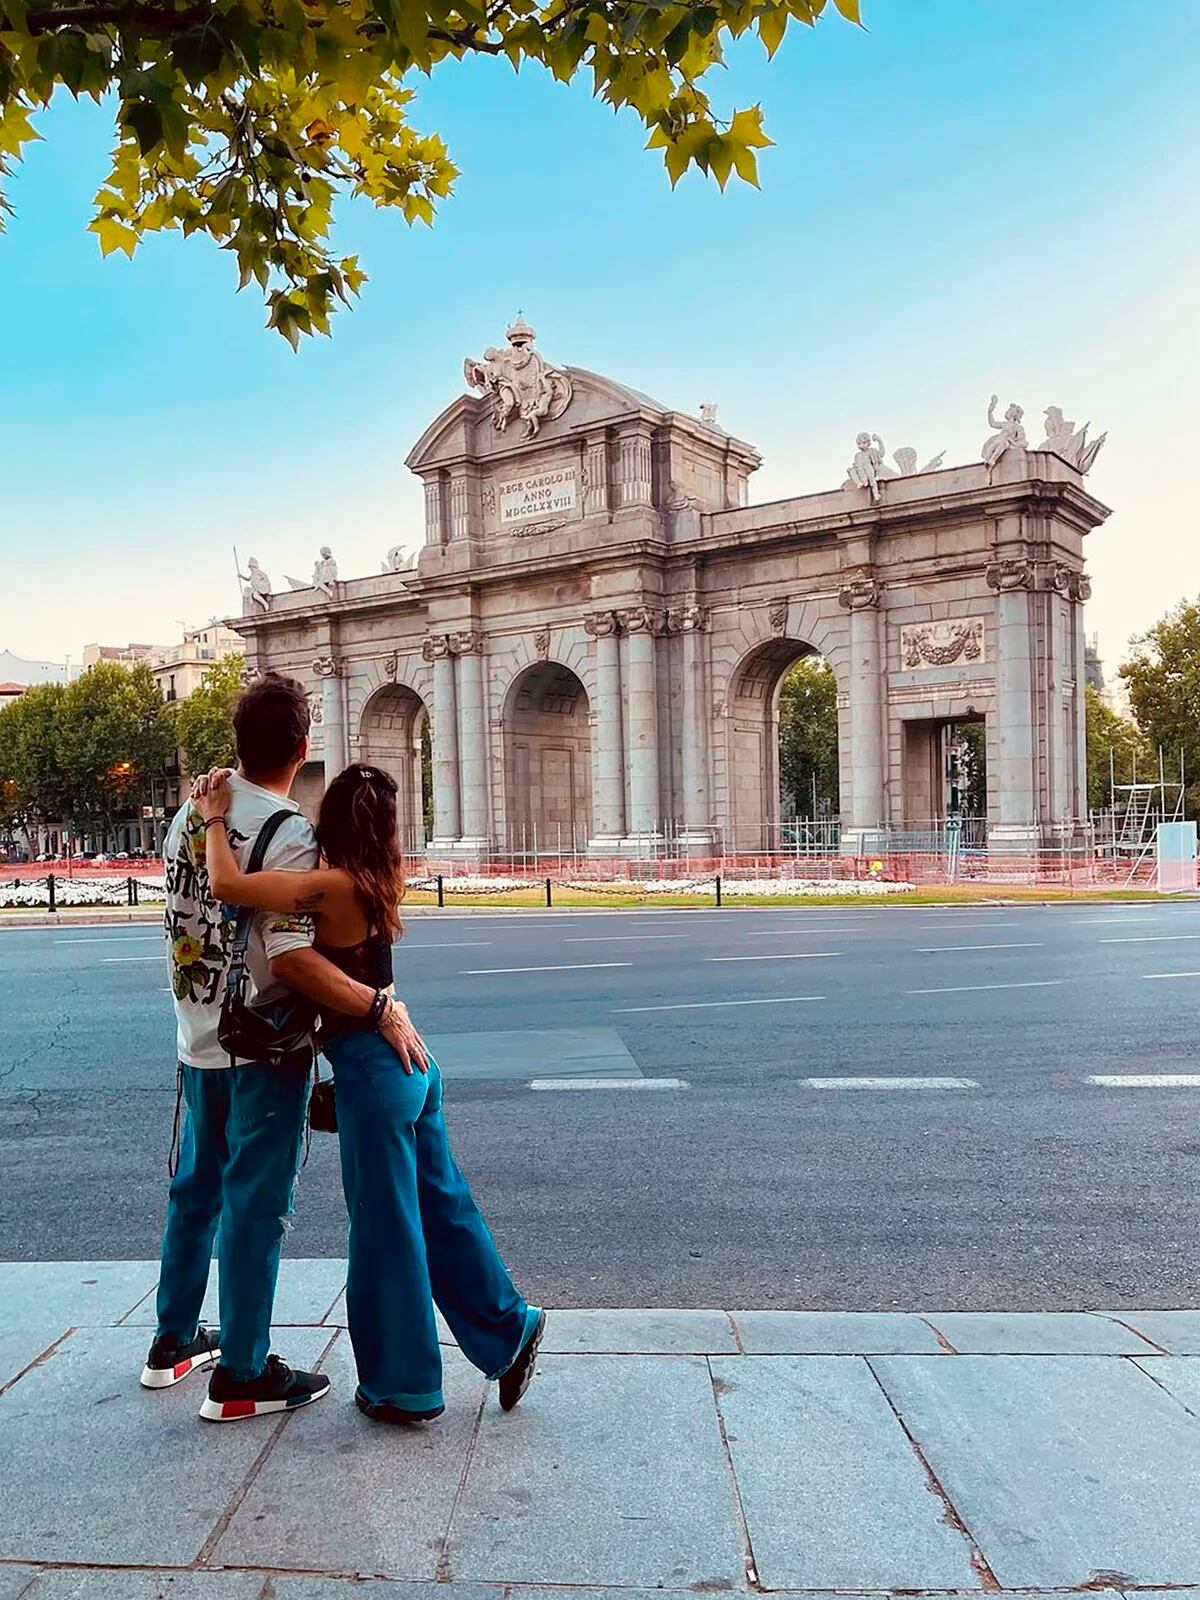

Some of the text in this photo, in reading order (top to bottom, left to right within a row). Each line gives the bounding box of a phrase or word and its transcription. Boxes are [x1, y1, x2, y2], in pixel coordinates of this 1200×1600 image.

[499, 471, 576, 495] REGE CAROLO III
[523, 489, 552, 502] ANNO
[505, 497, 571, 518] MDCCLXXVIII
